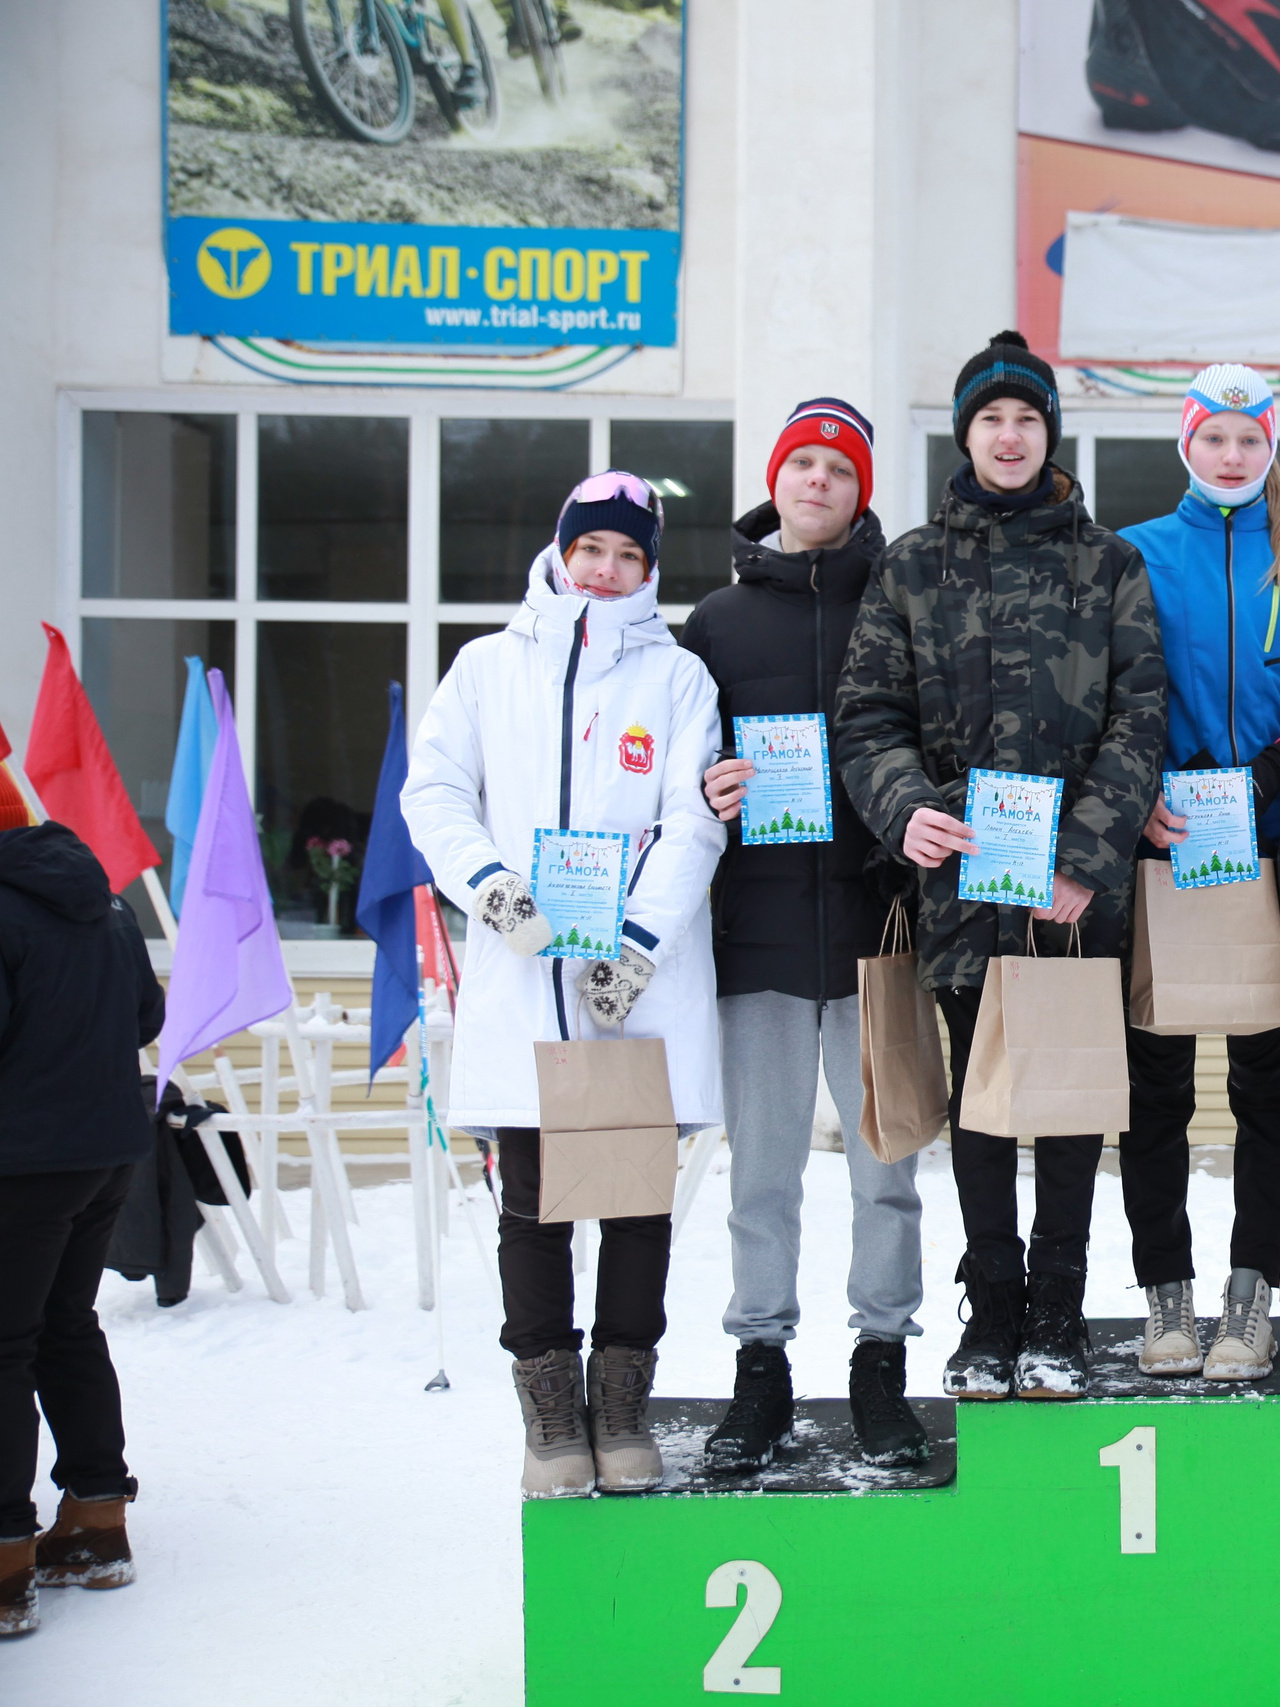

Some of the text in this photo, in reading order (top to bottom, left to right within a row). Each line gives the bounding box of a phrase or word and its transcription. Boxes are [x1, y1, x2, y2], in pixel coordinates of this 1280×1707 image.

[424, 305, 641, 333] www.trial-sport.ru
[753, 748, 811, 760] ГРАМОТА
[1181, 795, 1237, 808] ГРАМОТА
[982, 806, 1041, 822] ГРАМОТА
[549, 864, 609, 878] ГРАМОТА
[1098, 1426, 1156, 1554] 1
[703, 1558, 783, 1695] 2
